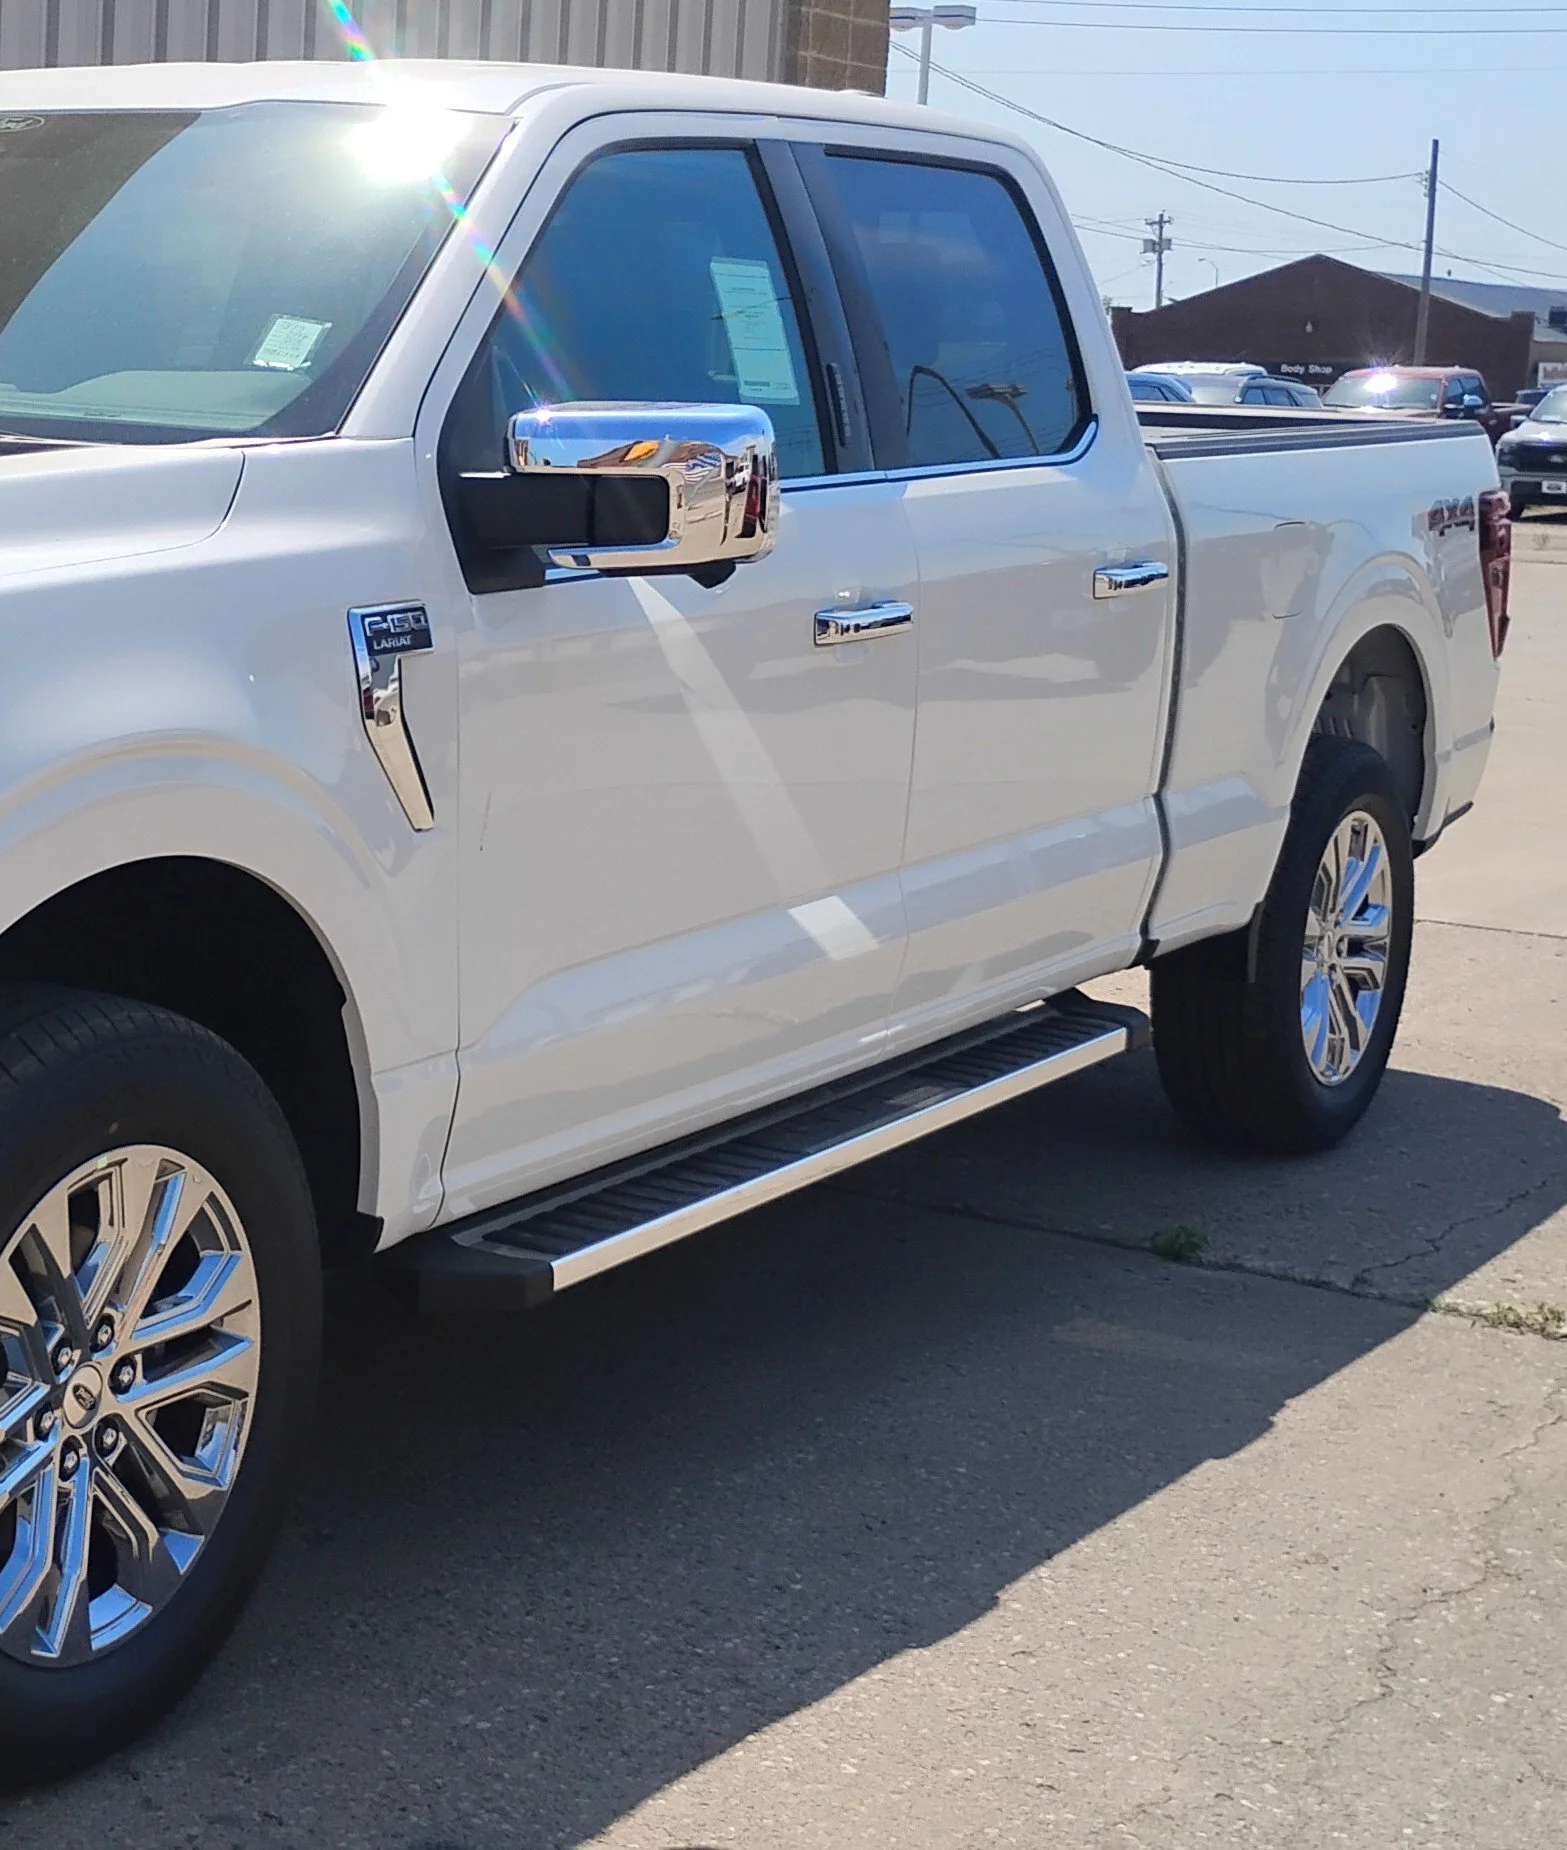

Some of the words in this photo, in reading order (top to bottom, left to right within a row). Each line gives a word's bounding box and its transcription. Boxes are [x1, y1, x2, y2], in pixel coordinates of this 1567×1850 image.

[1281, 364, 1305, 375] Body
[1309, 364, 1332, 374] Shop
[364, 611, 427, 636] F-150
[373, 635, 412, 650] LARIAT
